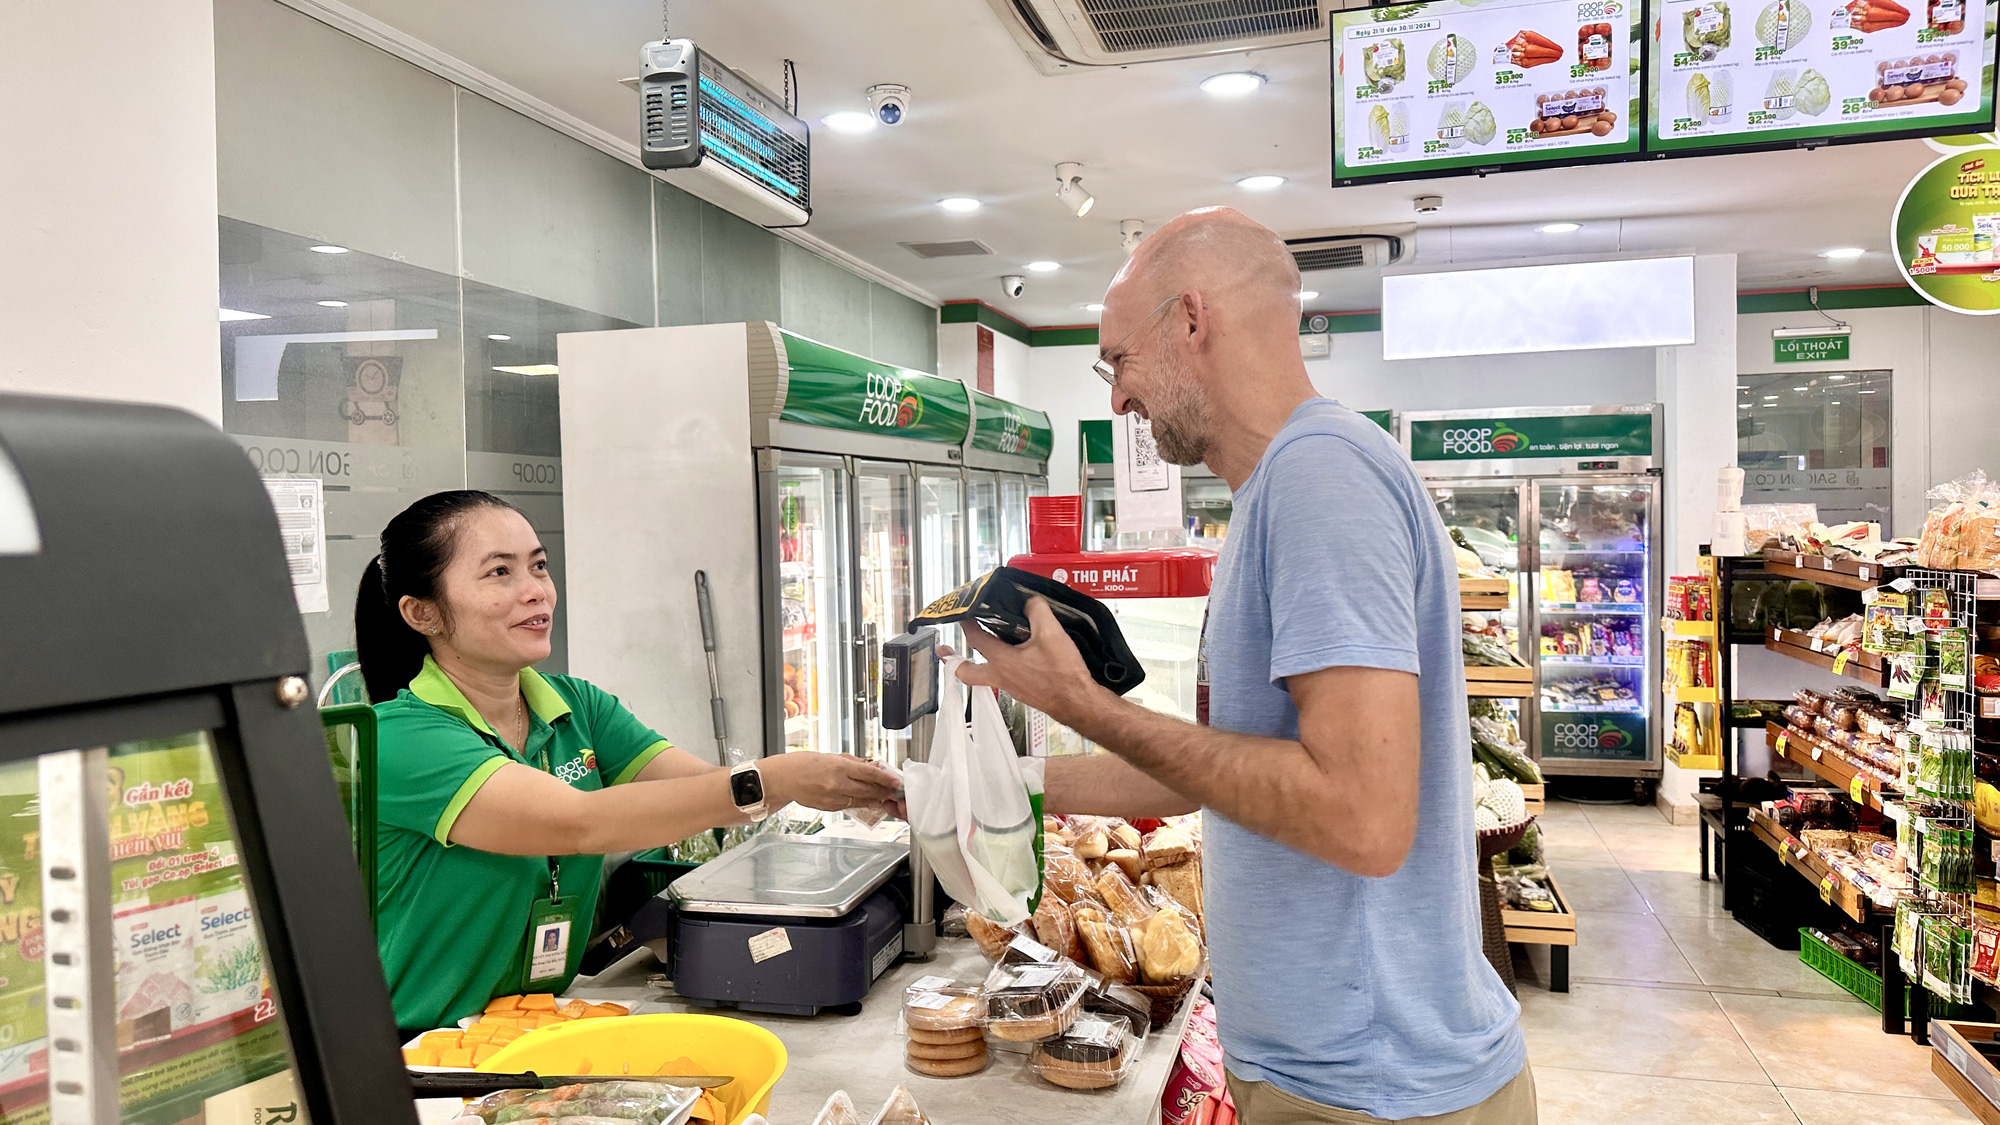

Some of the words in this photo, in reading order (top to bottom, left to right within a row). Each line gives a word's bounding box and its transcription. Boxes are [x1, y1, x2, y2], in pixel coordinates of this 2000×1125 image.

[1578, 8, 1603, 18] FOOD
[1842, 102, 1878, 114] 26.500
[1958, 171, 1985, 184] TÍCH
[1780, 340, 1800, 352] LỐI
[1802, 338, 1843, 351] THOÁT
[1796, 352, 1828, 360] EXIT
[859, 398, 898, 426] FOOD
[1444, 440, 1492, 454] FOOD
[1600, 442, 1619, 451] ngon
[1072, 570, 1098, 586] THỌ
[1102, 566, 1138, 582] PHÁT
[1554, 735, 1598, 748] FOOD
[558, 766, 588, 784] OOD
[126, 782, 160, 804] Gắn
[164, 778, 190, 798] kết
[168, 856, 180, 868] 01
[184, 852, 208, 864] trong
[194, 861, 222, 874] Select
[201, 906, 251, 932] Select
[130, 923, 182, 949] Select
